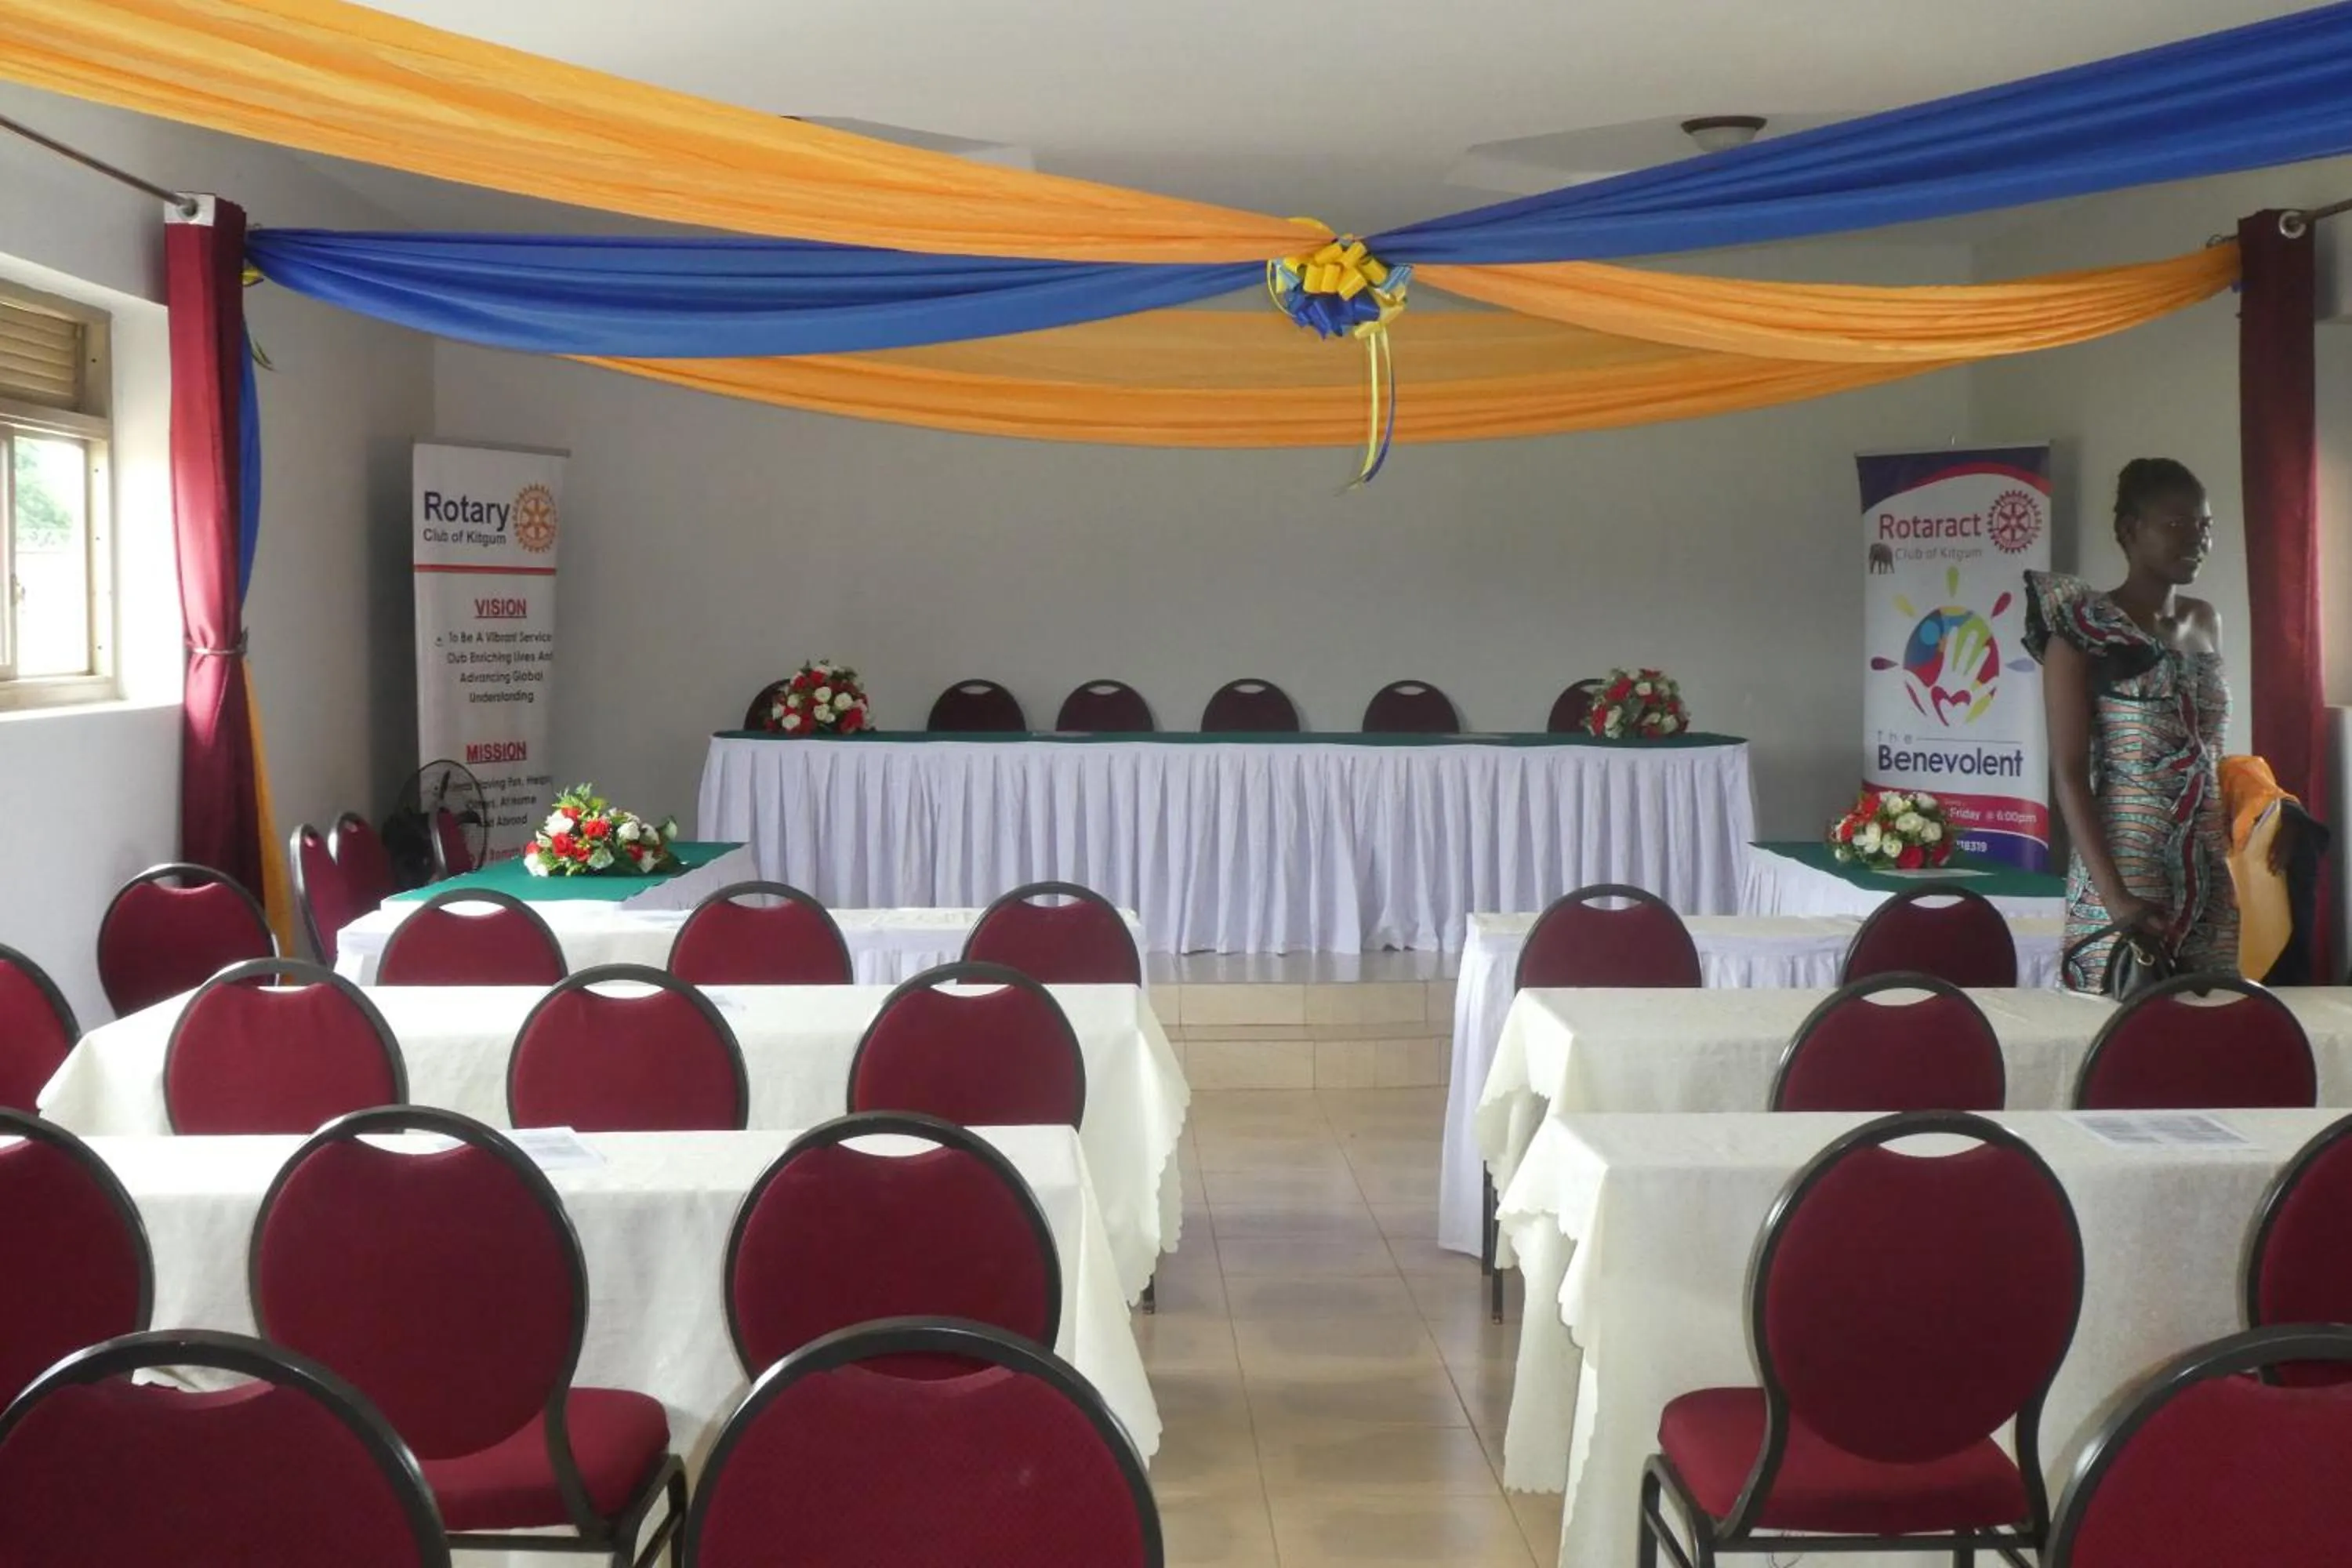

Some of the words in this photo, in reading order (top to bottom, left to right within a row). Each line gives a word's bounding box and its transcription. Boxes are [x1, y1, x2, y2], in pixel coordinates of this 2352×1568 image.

[423, 491, 510, 532] Rotary
[1879, 514, 1981, 539] Rotaract
[423, 528, 449, 543] Club
[452, 530, 463, 544] of
[466, 531, 506, 547] Kitgum
[1896, 548, 1922, 560] Club
[1926, 547, 1937, 559] of
[1940, 547, 1983, 561] Kitgum
[474, 599, 527, 618] VISION
[448, 632, 459, 642] To
[460, 632, 473, 643] Be
[476, 632, 484, 642] A
[485, 632, 517, 642] Vibrant
[519, 632, 552, 642] Service
[447, 652, 467, 663] Club
[470, 652, 512, 665] Enriching
[459, 673, 510, 684] Advancing
[513, 670, 543, 681] Global
[469, 690, 534, 702] Understanding
[1877, 730, 1913, 743] The
[466, 742, 527, 764] MISSION
[1878, 745, 2023, 776] Benevolent
[1950, 807, 1981, 821] Friday
